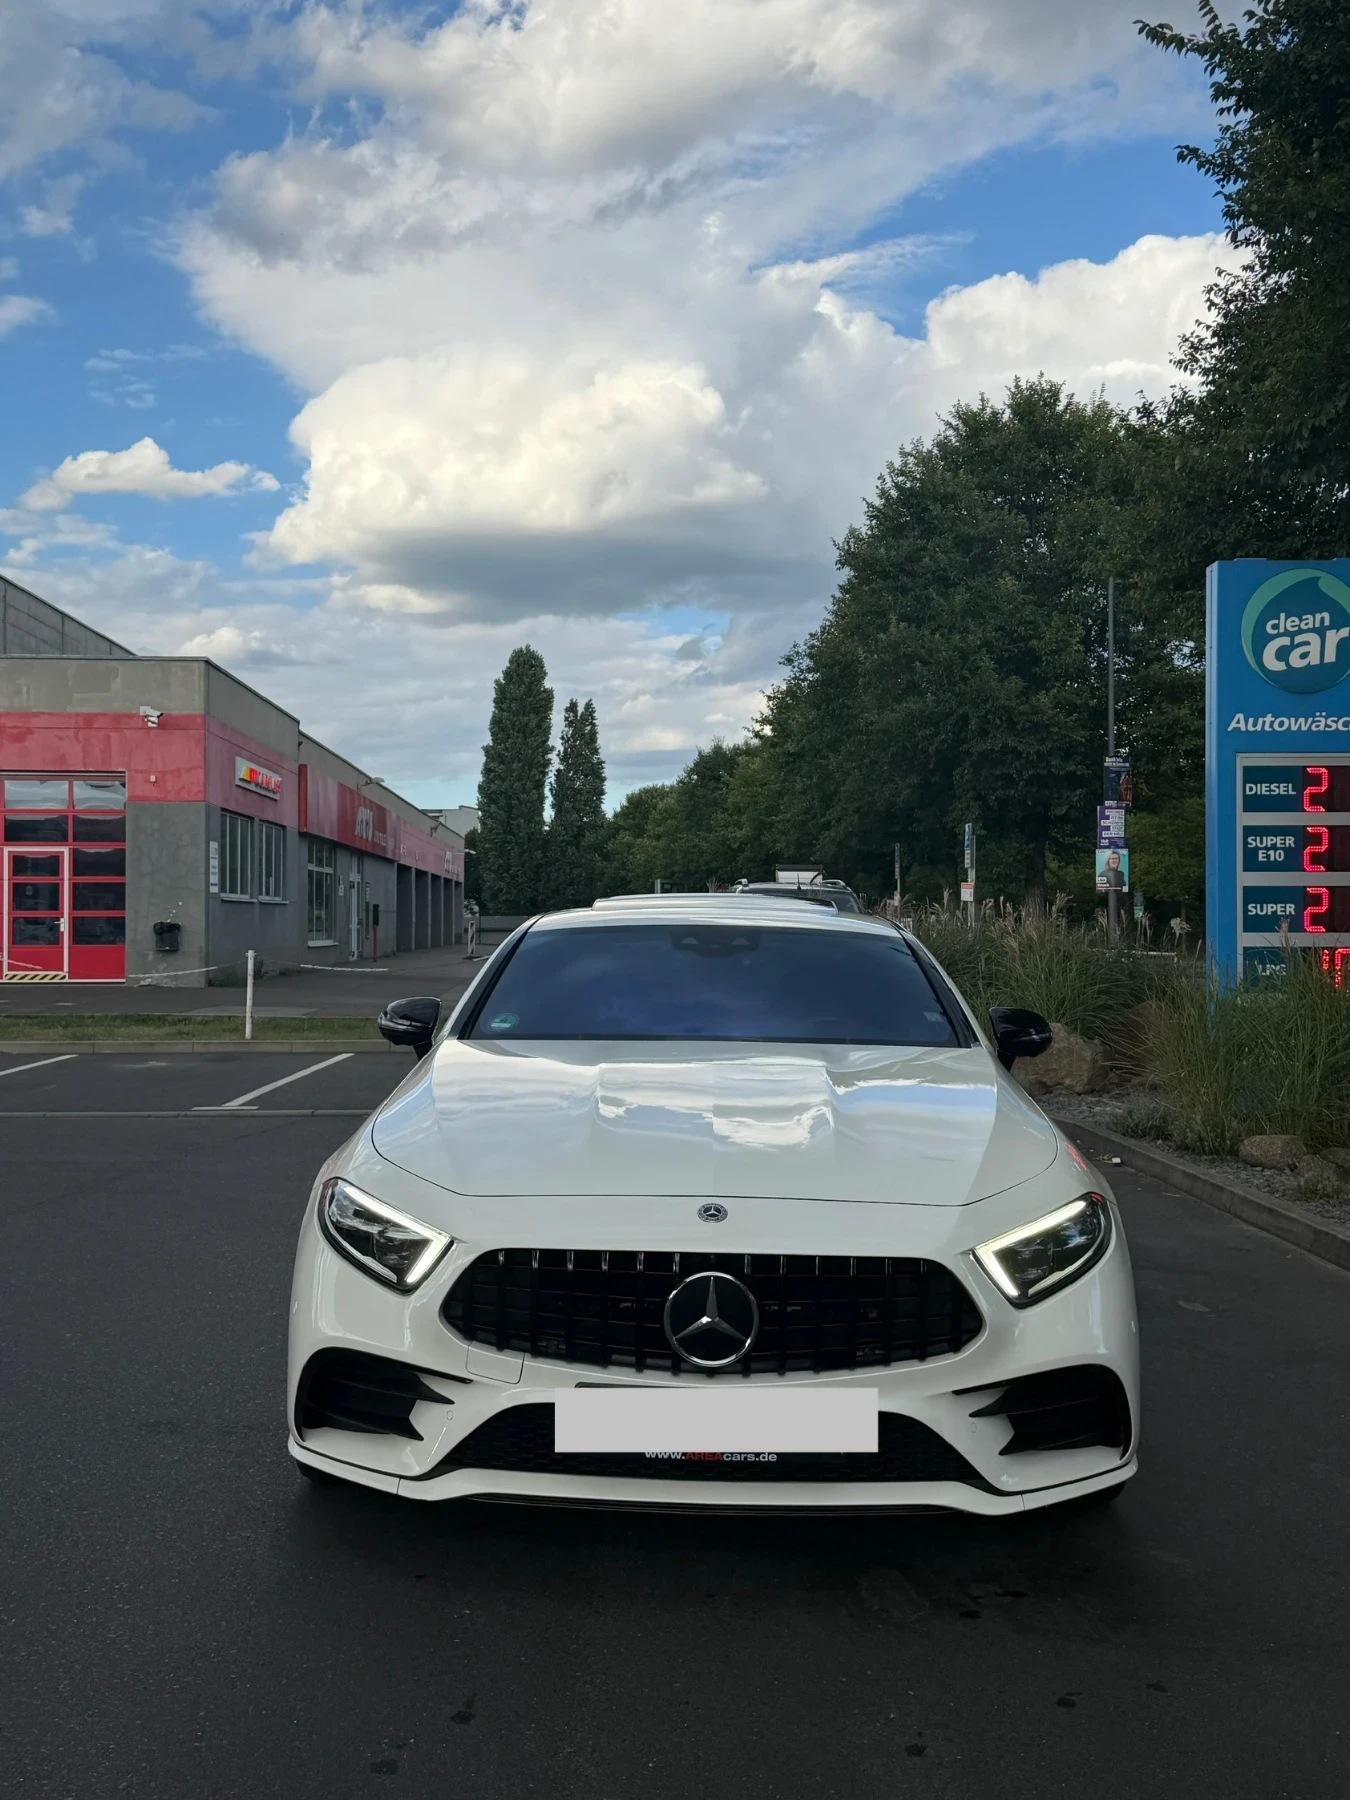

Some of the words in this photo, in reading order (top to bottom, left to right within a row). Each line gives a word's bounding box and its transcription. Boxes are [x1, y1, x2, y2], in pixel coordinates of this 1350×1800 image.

[1265, 611, 1330, 635] clean
[1262, 626, 1350, 672] car
[1227, 711, 1350, 732] Autowäsc
[1245, 783, 1297, 795] DIESEL
[1303, 767, 1329, 812] 2
[1247, 836, 1296, 848] SUPER
[1303, 826, 1329, 872] 2
[1258, 850, 1285, 862] E10
[1247, 903, 1296, 916] SUPER
[1303, 887, 1330, 932] 2
[644, 1451, 777, 1461] www.AREAcars.de
